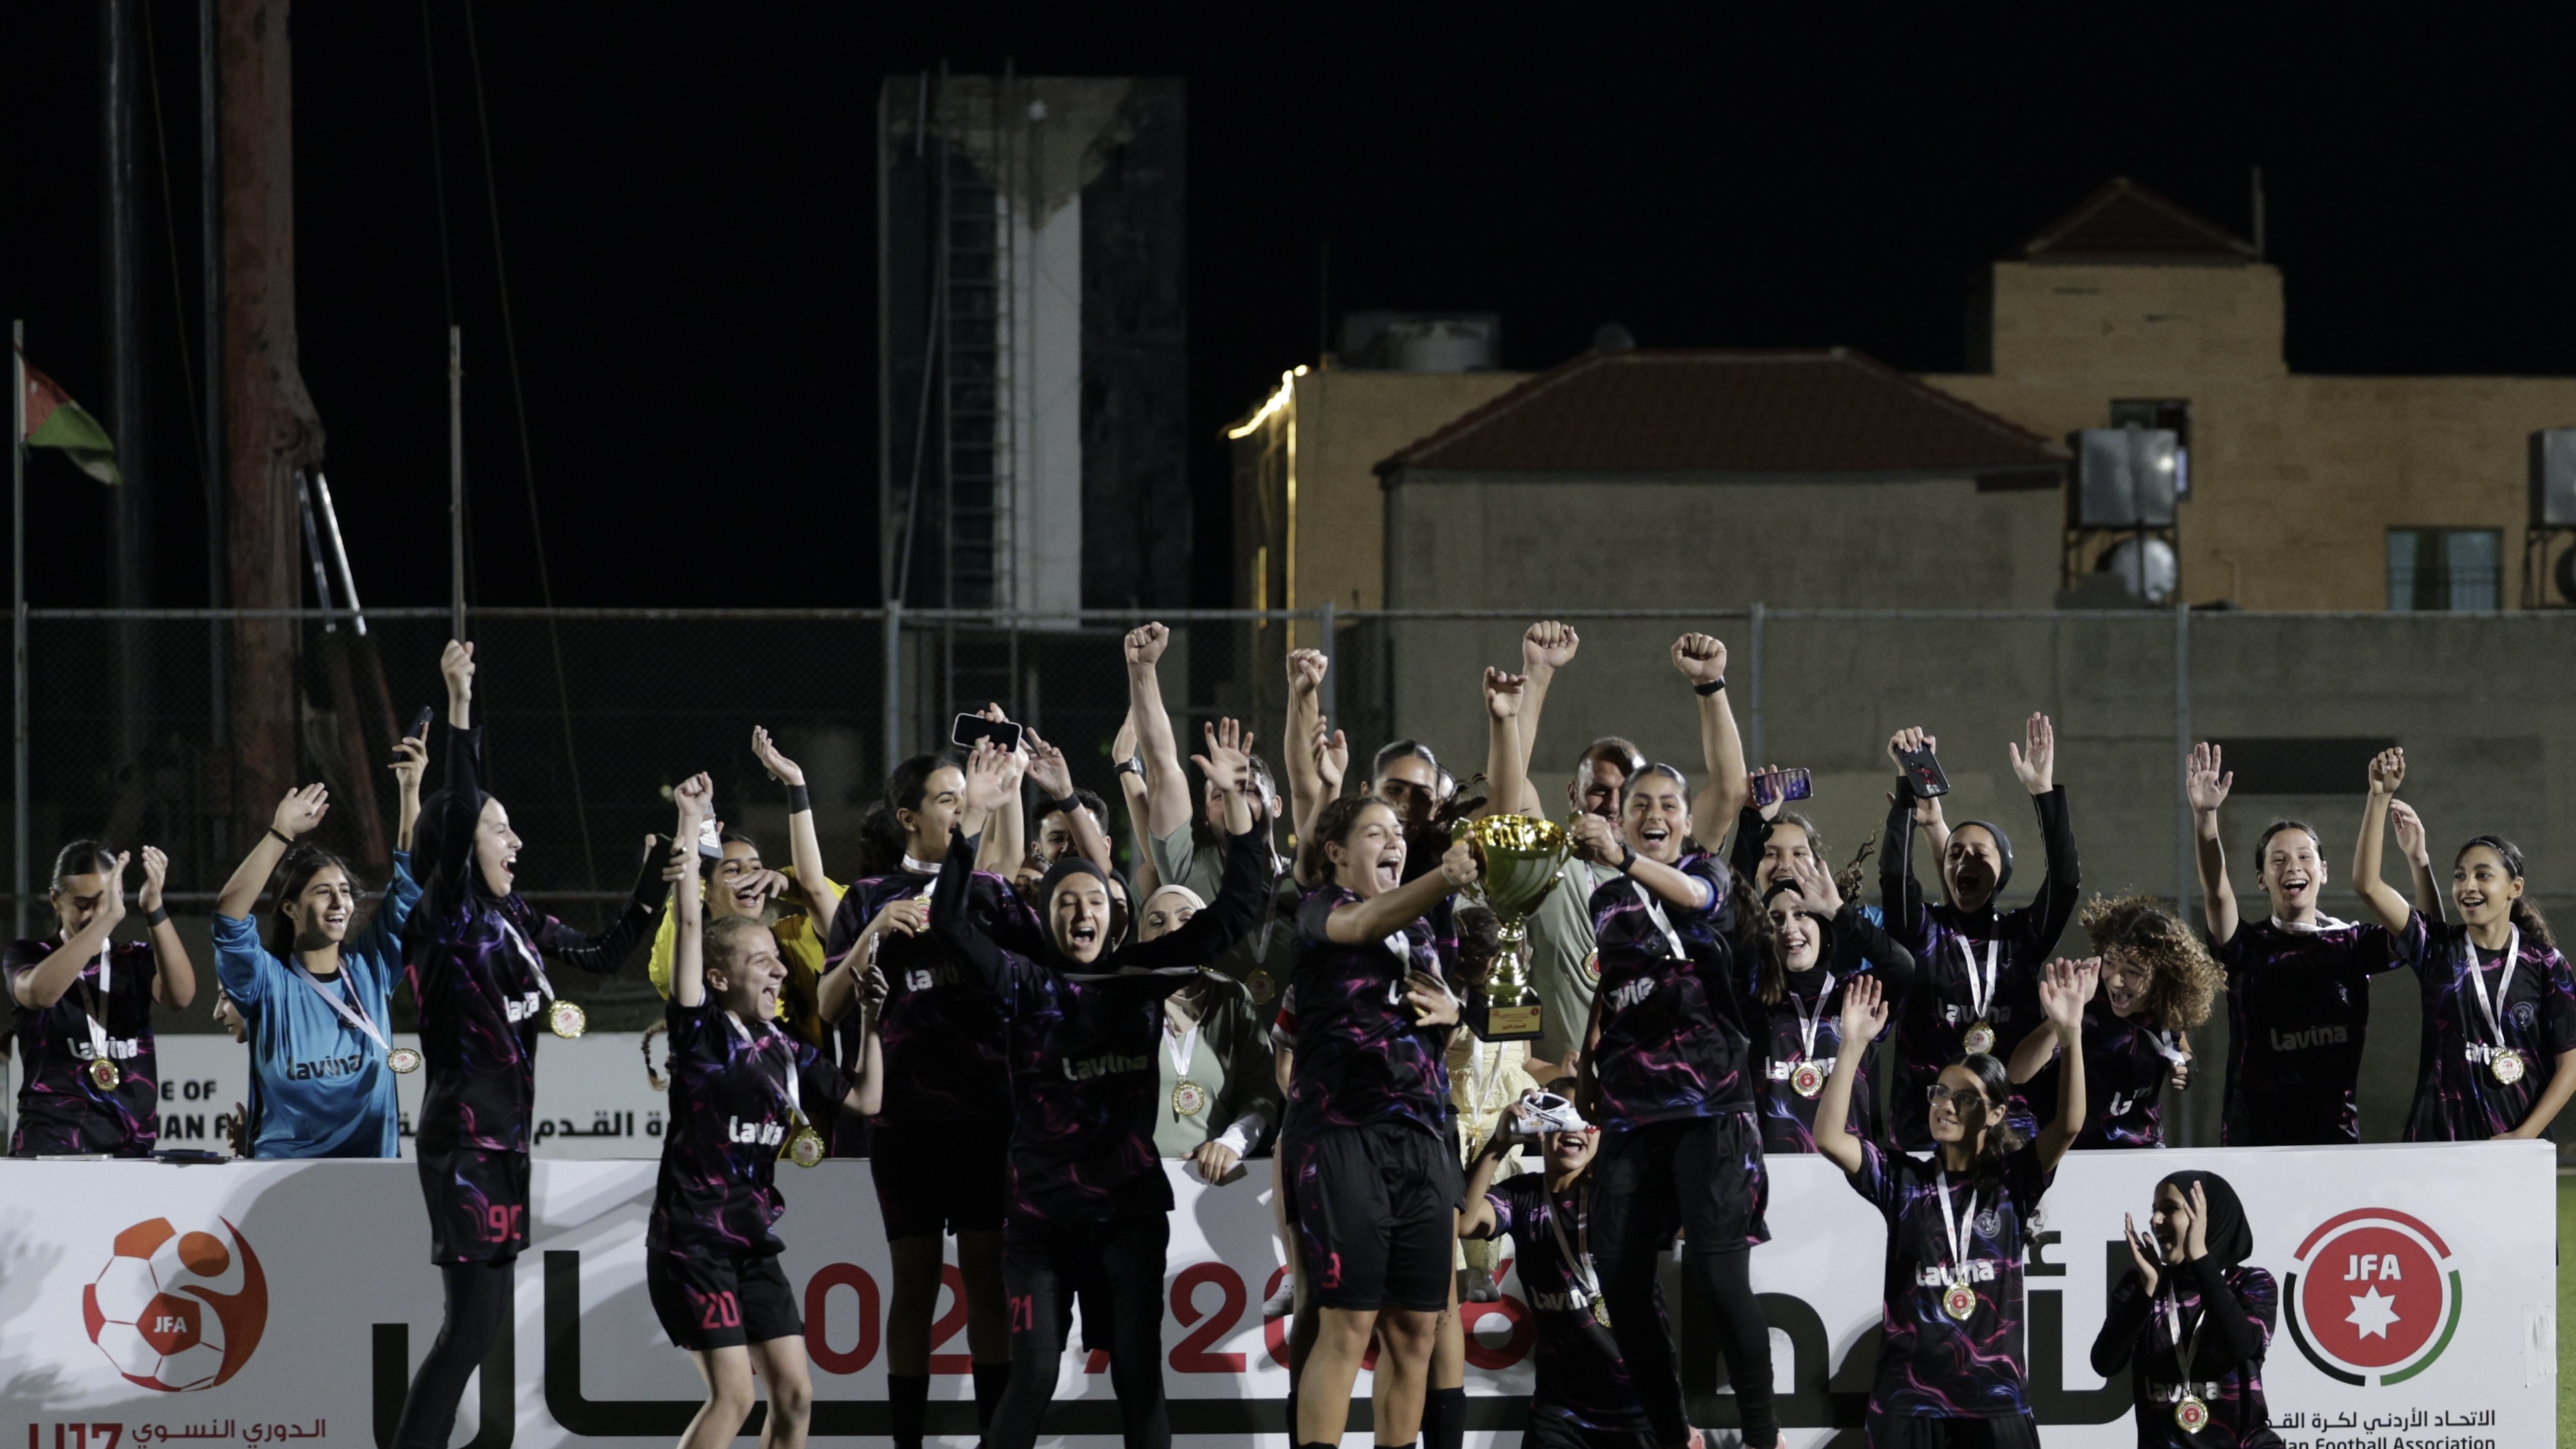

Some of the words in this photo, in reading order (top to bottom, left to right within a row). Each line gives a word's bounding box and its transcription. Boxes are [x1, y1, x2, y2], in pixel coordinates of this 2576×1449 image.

[183, 1080, 217, 1101] OF
[534, 1110, 634, 1145] القدم
[2344, 1253, 2402, 1281] JFA
[153, 1315, 188, 1334] JFA
[2311, 1411, 2357, 1433] لكرة
[2363, 1407, 2428, 1435] الأردني
[2434, 1409, 2496, 1427] الاتحاد
[132, 1418, 236, 1449] النسوي
[242, 1418, 326, 1449] الدوري
